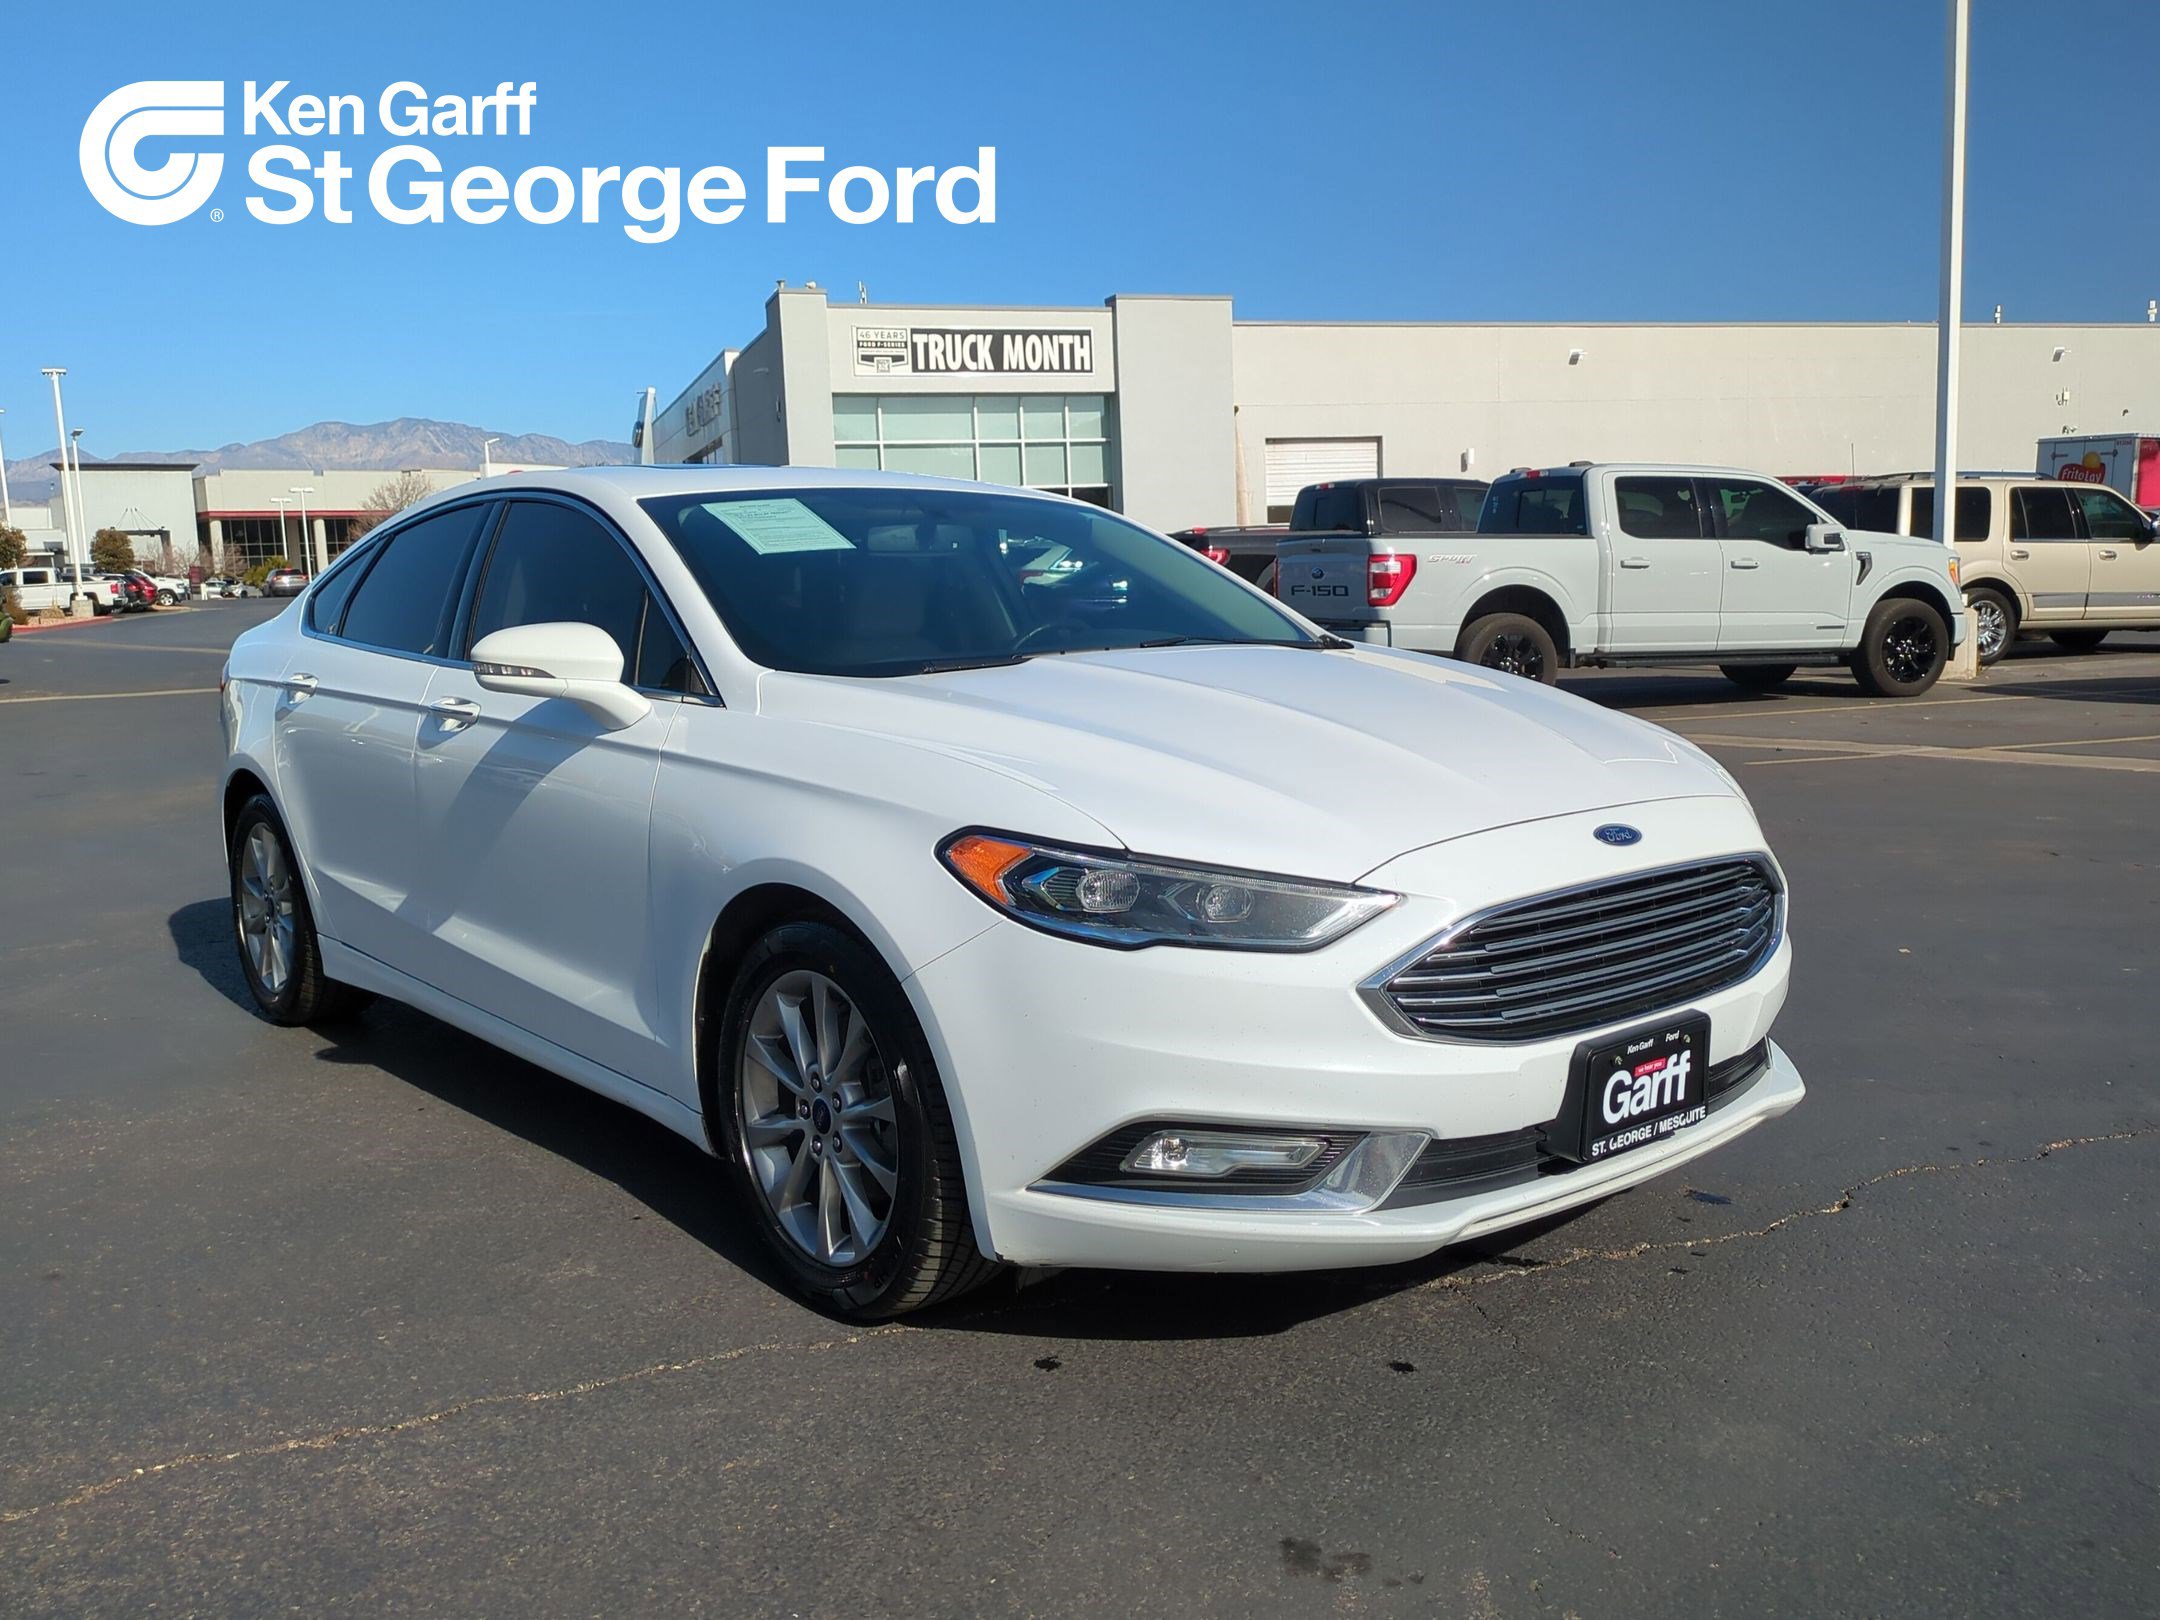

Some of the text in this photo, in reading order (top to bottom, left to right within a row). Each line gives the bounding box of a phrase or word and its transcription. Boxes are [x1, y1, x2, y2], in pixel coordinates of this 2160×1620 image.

[860, 331, 905, 340] 46 YEARS
[912, 333, 1091, 372] TRUCK MONTH
[1291, 585, 1349, 596] F-150
[1665, 1030, 1680, 1042] Ford
[1627, 1038, 1654, 1055] Ken Garff
[1602, 1050, 1691, 1124] Garff
[1591, 1140, 1607, 1156] ST.
[1609, 1125, 1652, 1150] GEORGE
